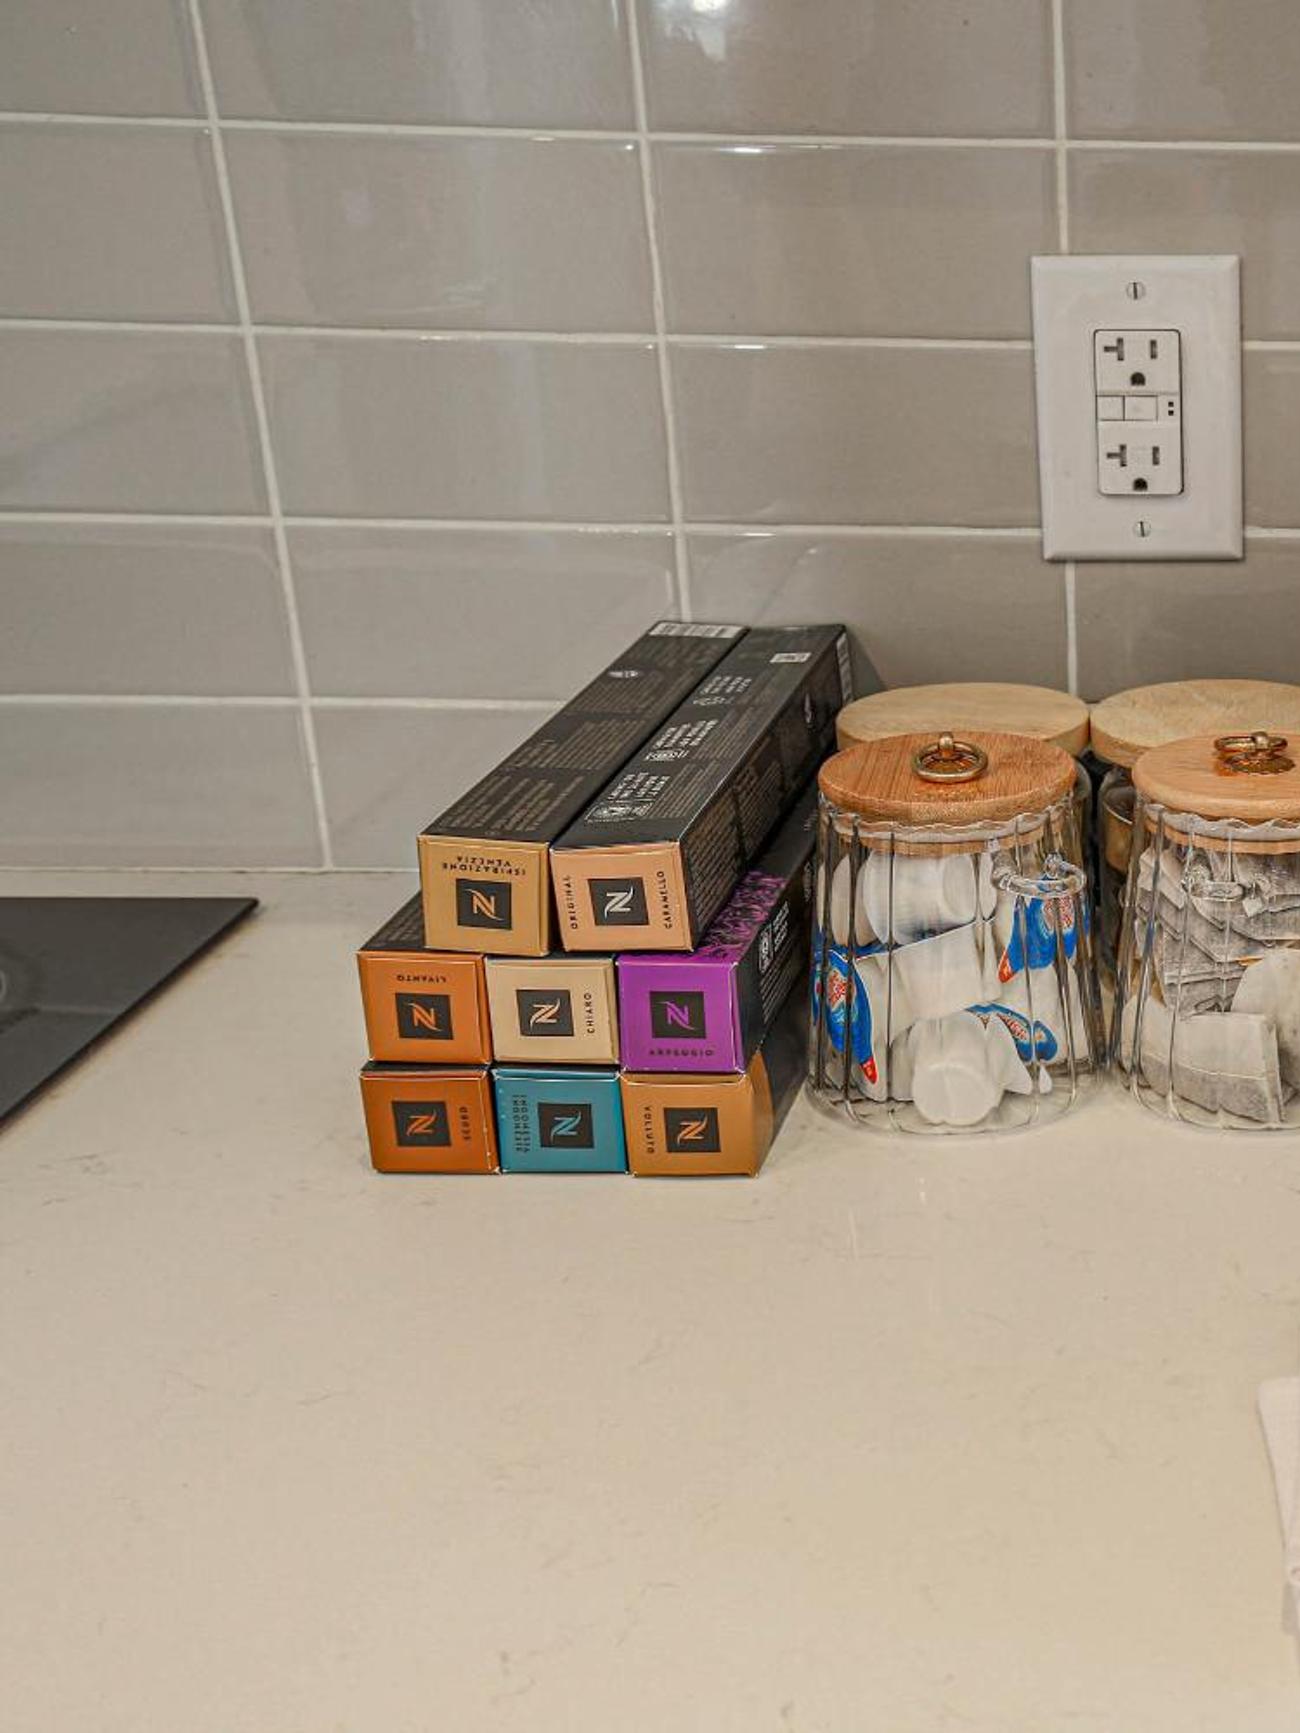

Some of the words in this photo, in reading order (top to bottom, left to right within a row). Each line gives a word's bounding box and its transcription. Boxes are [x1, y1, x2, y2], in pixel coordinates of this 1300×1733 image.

[441, 861, 527, 876] ISPIRAZIONE
[456, 854, 513, 867] VENEZIA
[562, 874, 579, 930] ORIGINAL
[655, 870, 673, 930] CARAMELLO
[396, 973, 448, 984] LIVANTO
[584, 992, 595, 1034] CHIARO
[649, 1048, 716, 1058] ARPEGGIO
[644, 1104, 656, 1154] VOLLUTO
